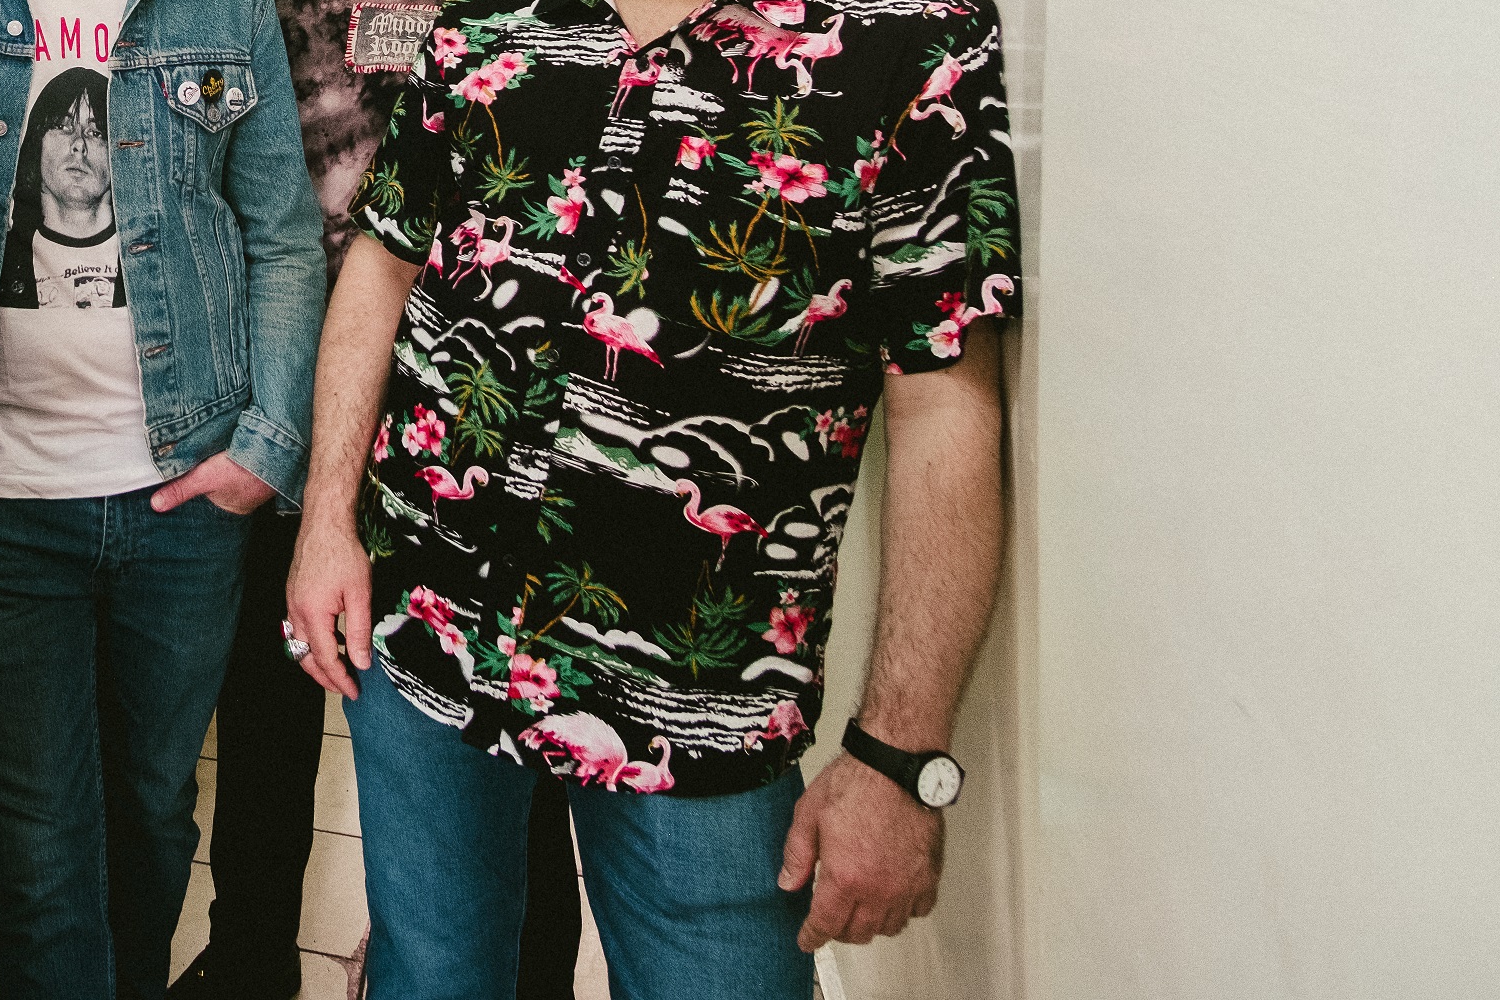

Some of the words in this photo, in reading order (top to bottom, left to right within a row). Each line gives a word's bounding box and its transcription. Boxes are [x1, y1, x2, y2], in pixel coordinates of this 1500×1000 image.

[35, 16, 109, 63] AMO
[202, 77, 224, 95] Cherry
[63, 264, 102, 279] Believe
